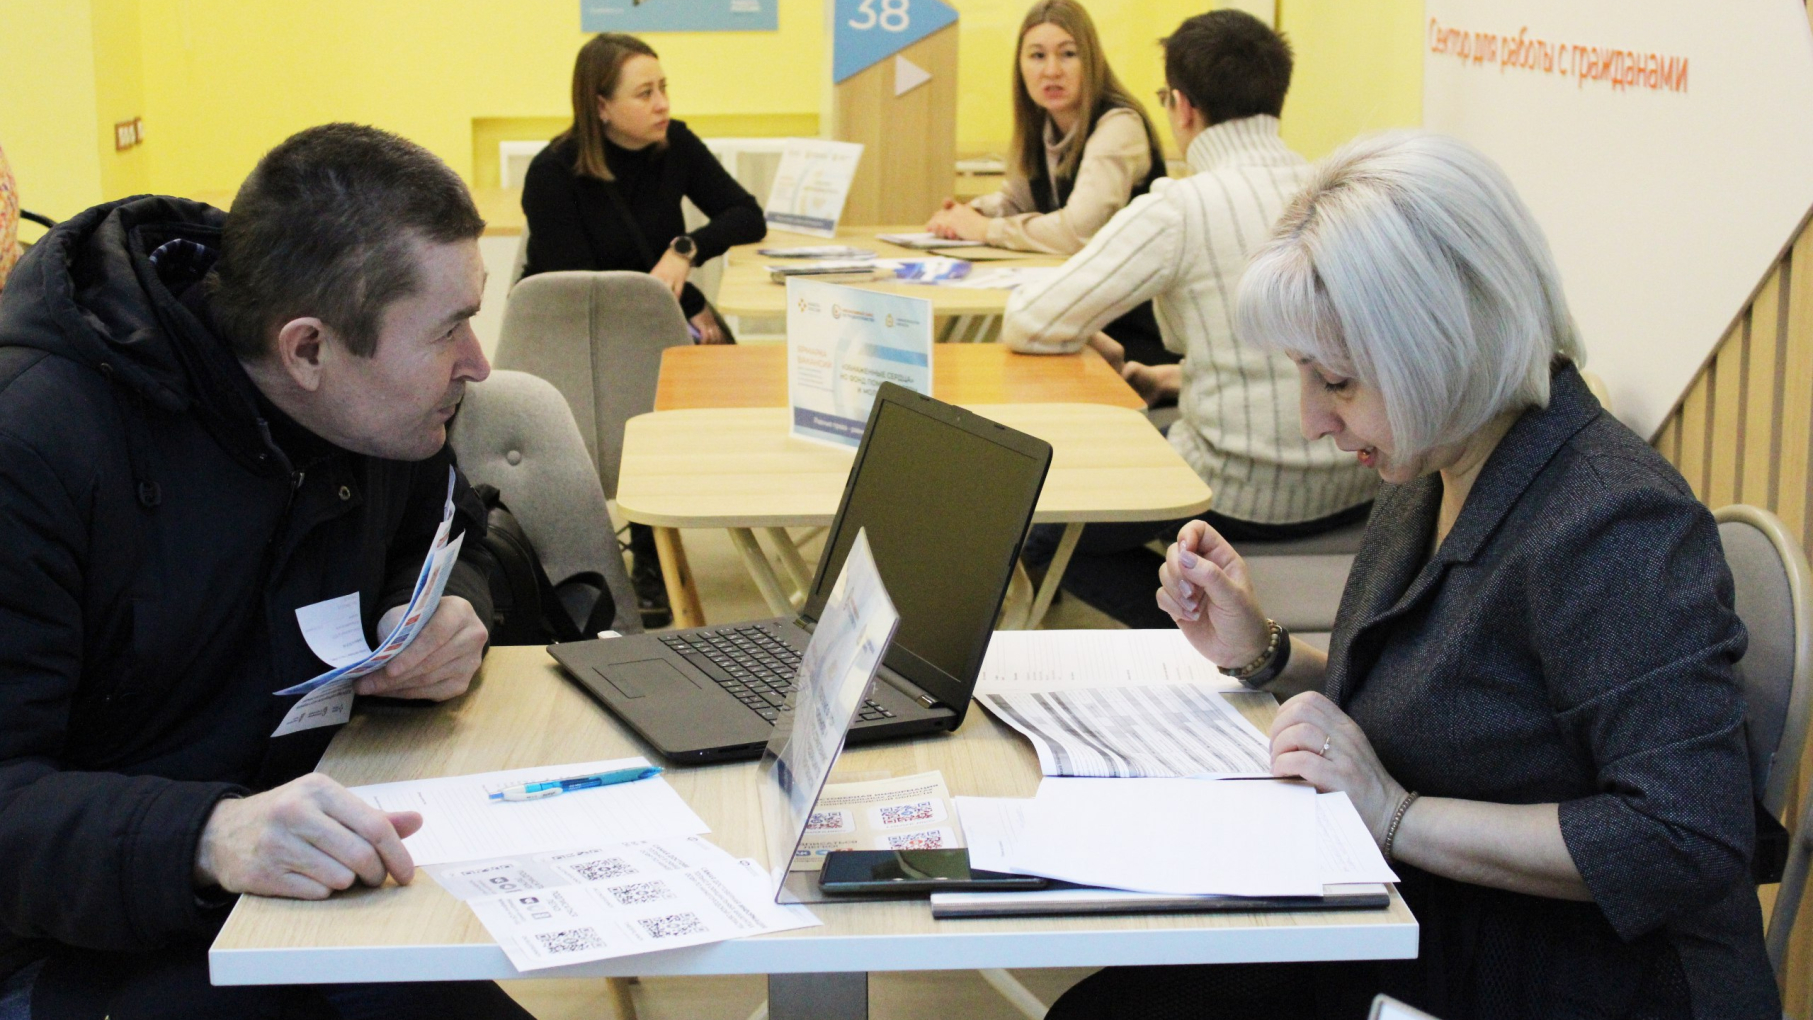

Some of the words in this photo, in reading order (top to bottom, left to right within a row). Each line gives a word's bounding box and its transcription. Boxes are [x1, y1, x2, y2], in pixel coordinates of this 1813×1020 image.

[849, 0, 910, 31] 38
[1430, 18, 1470, 67] Сектор
[1473, 33, 1497, 65] для
[1501, 26, 1554, 74] работы
[1558, 43, 1568, 76] с
[1572, 44, 1689, 94] гражданами
